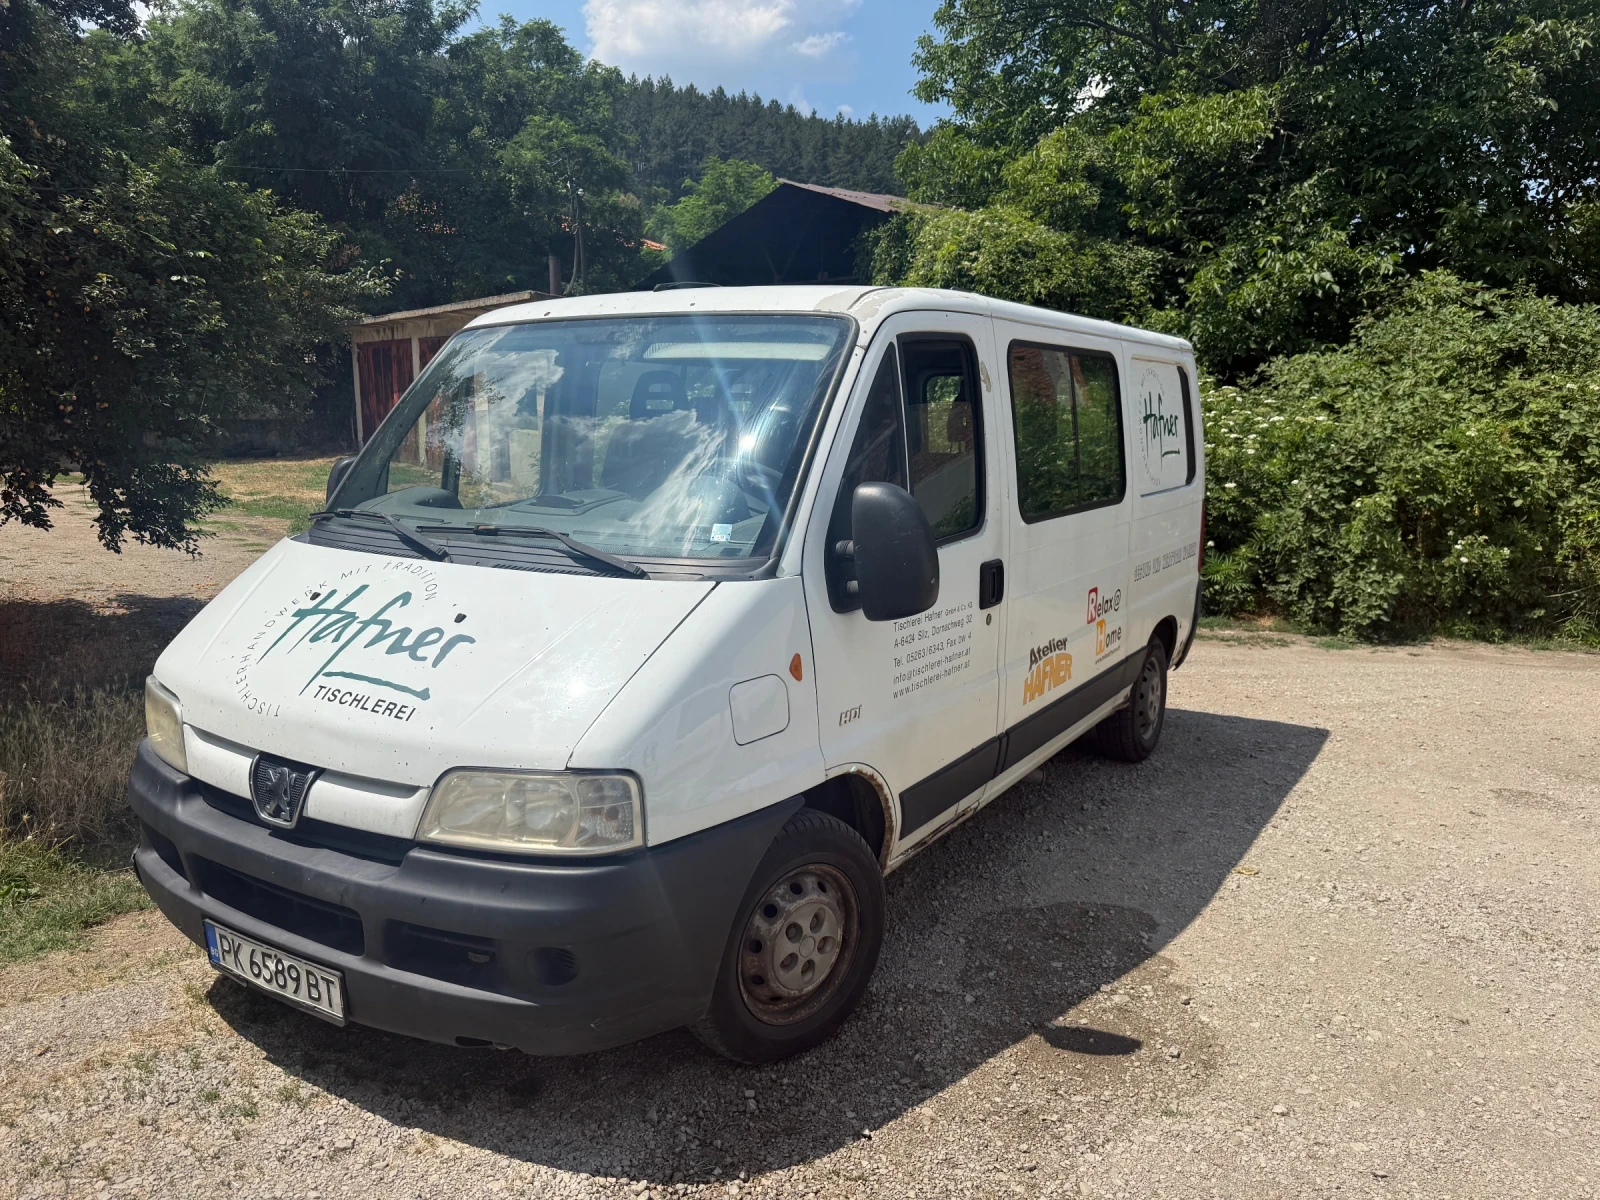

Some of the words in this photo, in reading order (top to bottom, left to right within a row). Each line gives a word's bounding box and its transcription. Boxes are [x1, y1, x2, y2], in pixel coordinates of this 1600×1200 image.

[1143, 391, 1178, 472] Hafner
[340, 563, 373, 580] MIT
[382, 560, 438, 602] TRADITION
[256, 584, 477, 696] Hafner
[893, 615, 923, 633] Tischlerei
[924, 609, 943, 623] Hafner
[893, 632, 915, 649] A-6424
[946, 638, 957, 649] Fax
[1028, 637, 1068, 672] Atelier
[892, 660, 971, 699] www.tischlerei-hafner.at
[893, 646, 971, 685] info@tischlerei-hafner.at
[1022, 653, 1073, 706] HAFNER
[313, 685, 417, 722] TISCHLEREI
[210, 946, 220, 958] BG
[218, 932, 246, 973] PK
[249, 948, 301, 995] 6589
[305, 969, 335, 1009] BT
